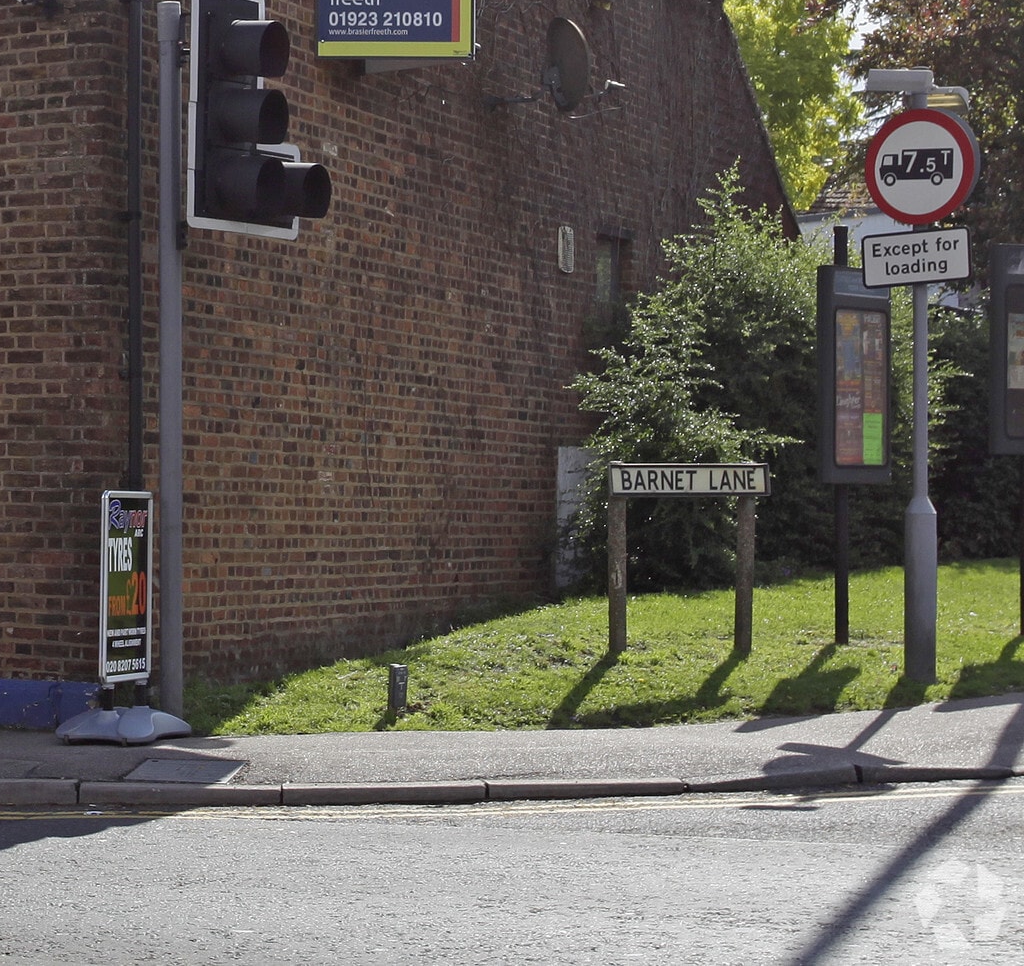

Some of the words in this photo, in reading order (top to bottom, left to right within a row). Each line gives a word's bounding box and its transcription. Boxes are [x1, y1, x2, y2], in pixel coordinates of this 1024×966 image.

[328, 12, 378, 27] 01923
[383, 12, 443, 27] 210810
[328, 28, 408, 36] www.brasierfreeth.com
[872, 239, 929, 258] Except
[936, 237, 960, 252] for
[885, 258, 948, 276] loading
[621, 470, 697, 491] BARNET
[709, 470, 757, 491] LANE
[108, 499, 148, 533] Raynor
[108, 537, 133, 572] TYRES
